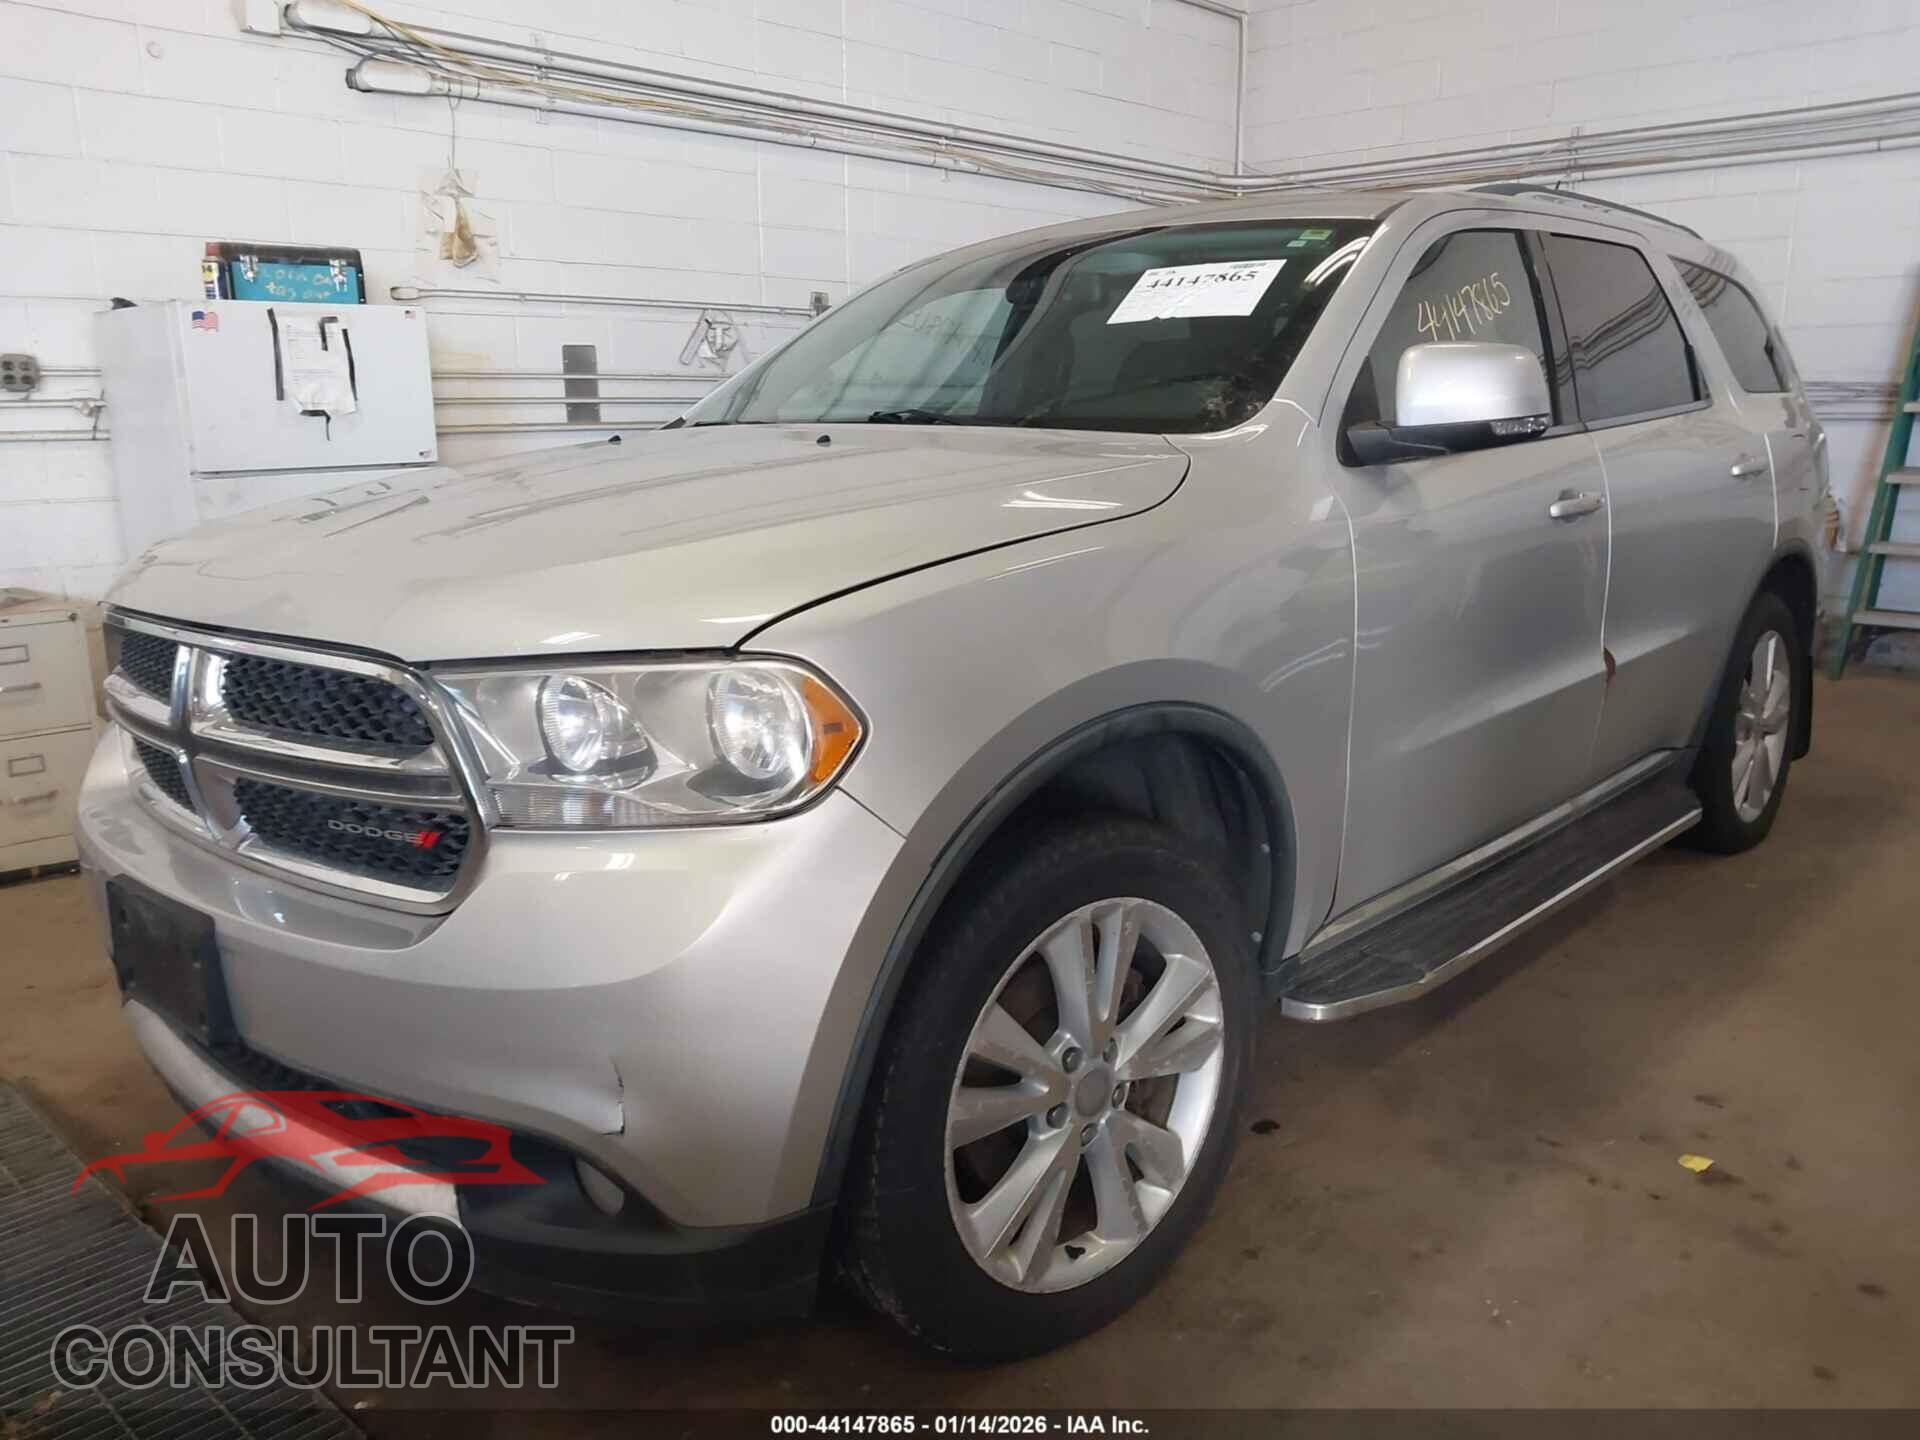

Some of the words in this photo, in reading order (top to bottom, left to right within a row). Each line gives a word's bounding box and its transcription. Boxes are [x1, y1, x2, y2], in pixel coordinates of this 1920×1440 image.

[1145, 269, 1259, 289] 44147865
[1417, 271, 1511, 342] 44147865
[327, 819, 424, 844] DODGE
